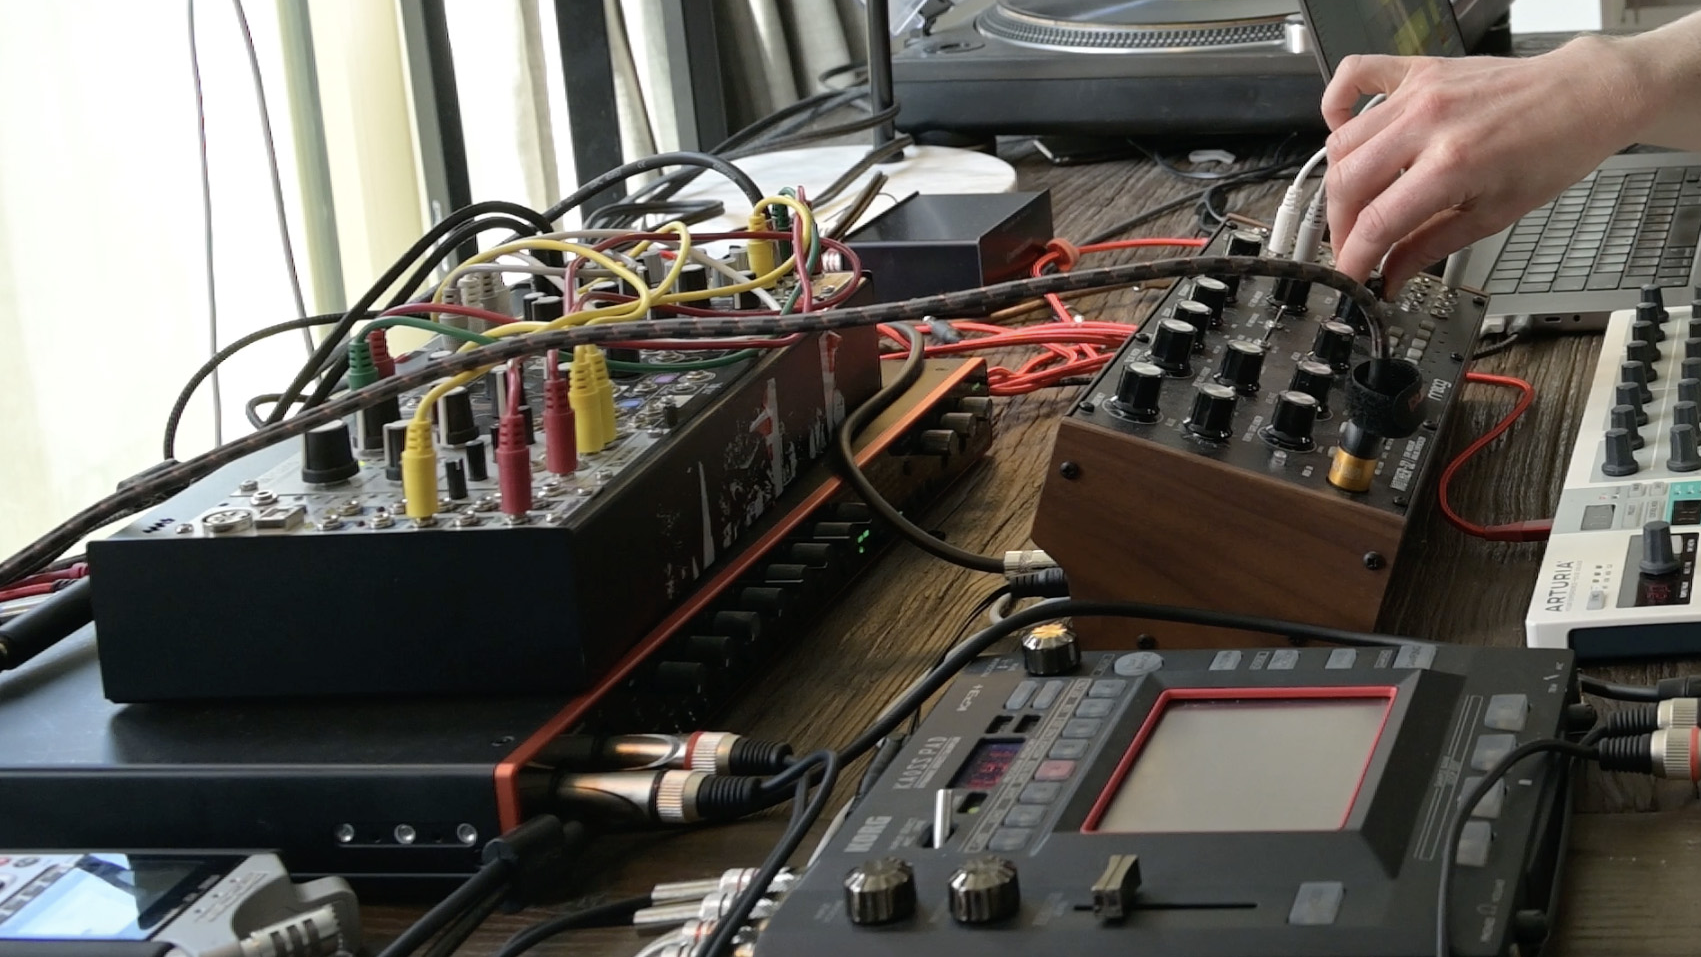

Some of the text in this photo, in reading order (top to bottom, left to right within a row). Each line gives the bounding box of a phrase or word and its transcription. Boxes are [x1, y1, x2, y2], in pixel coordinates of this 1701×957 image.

[1428, 378, 1452, 401] moog
[1545, 561, 1574, 612] ARTURIA
[893, 757, 933, 790] KAOSS
[918, 736, 949, 756] PAD
[844, 816, 893, 853] KORG
